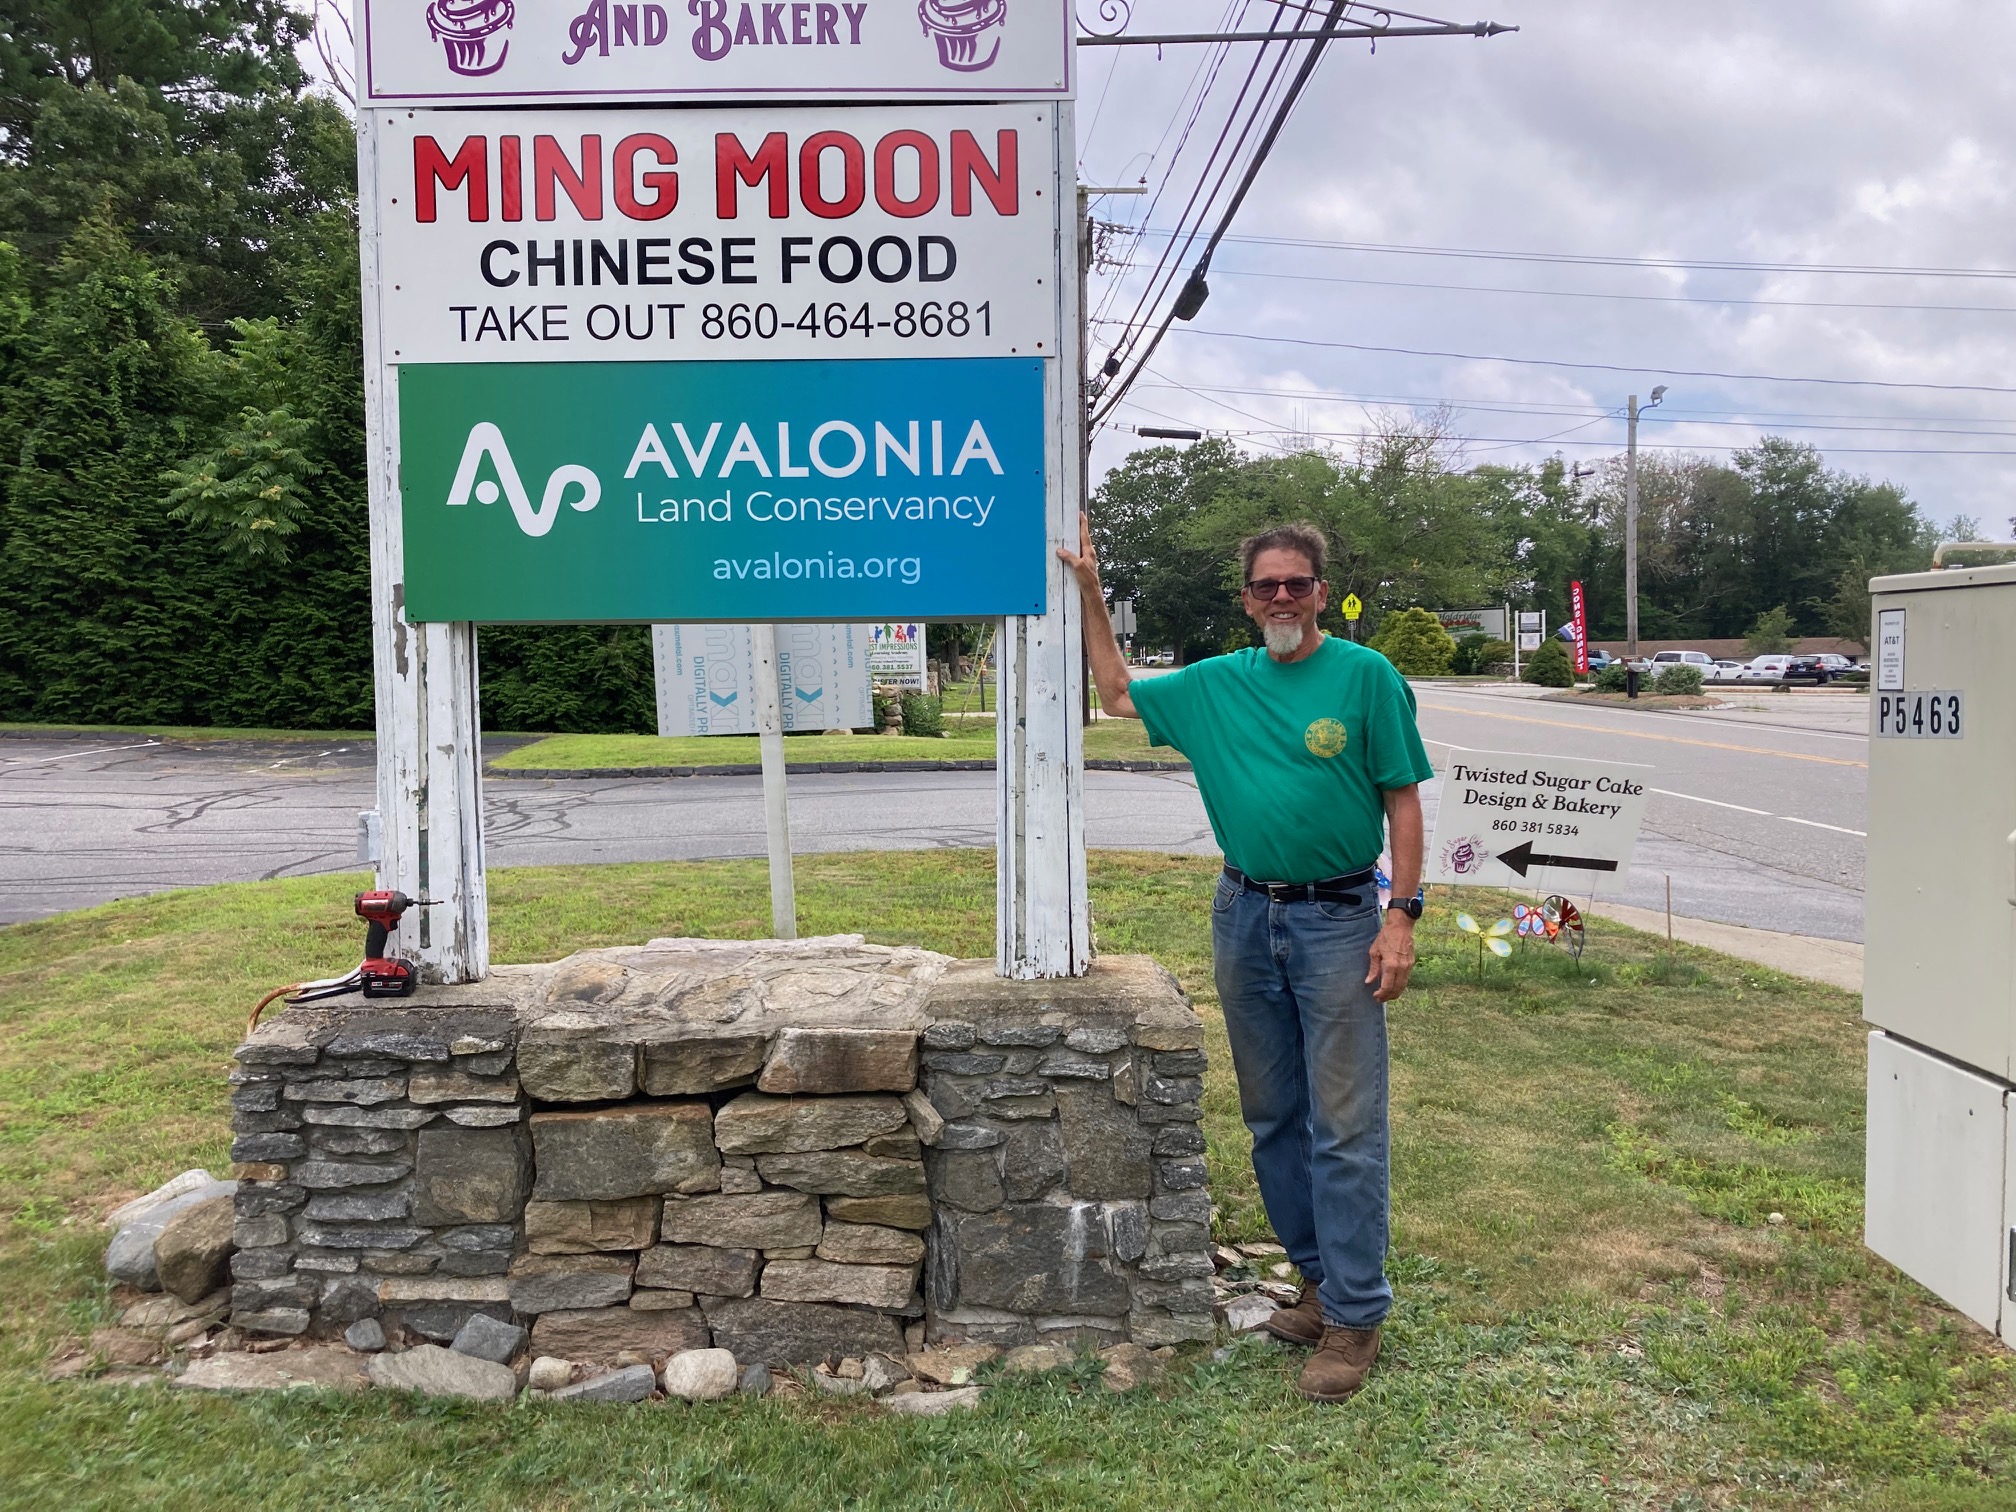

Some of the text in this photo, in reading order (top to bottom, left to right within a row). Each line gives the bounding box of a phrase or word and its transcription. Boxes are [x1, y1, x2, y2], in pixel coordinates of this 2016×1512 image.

[562, 0, 868, 65] AND BAKERY
[413, 129, 1019, 223] MING MOON
[480, 235, 957, 287] CHINESE FOOD
[449, 300, 991, 342] TAKE OUT 860-464-8681
[623, 419, 1004, 479] AVALONIA
[637, 490, 996, 527] Land Conservancy
[713, 550, 921, 585] avalonia.org
[1884, 636, 1900, 645] AT&T
[693, 656, 708, 714] DIGITALLY
[779, 652, 793, 710] DIGITALLY
[1880, 696, 1960, 735] P5463
[1453, 765, 1643, 796] Twisted Sugar Cake
[1463, 789, 1622, 819] Design & Bakery
[1492, 820, 1579, 836] 860 381 5834
